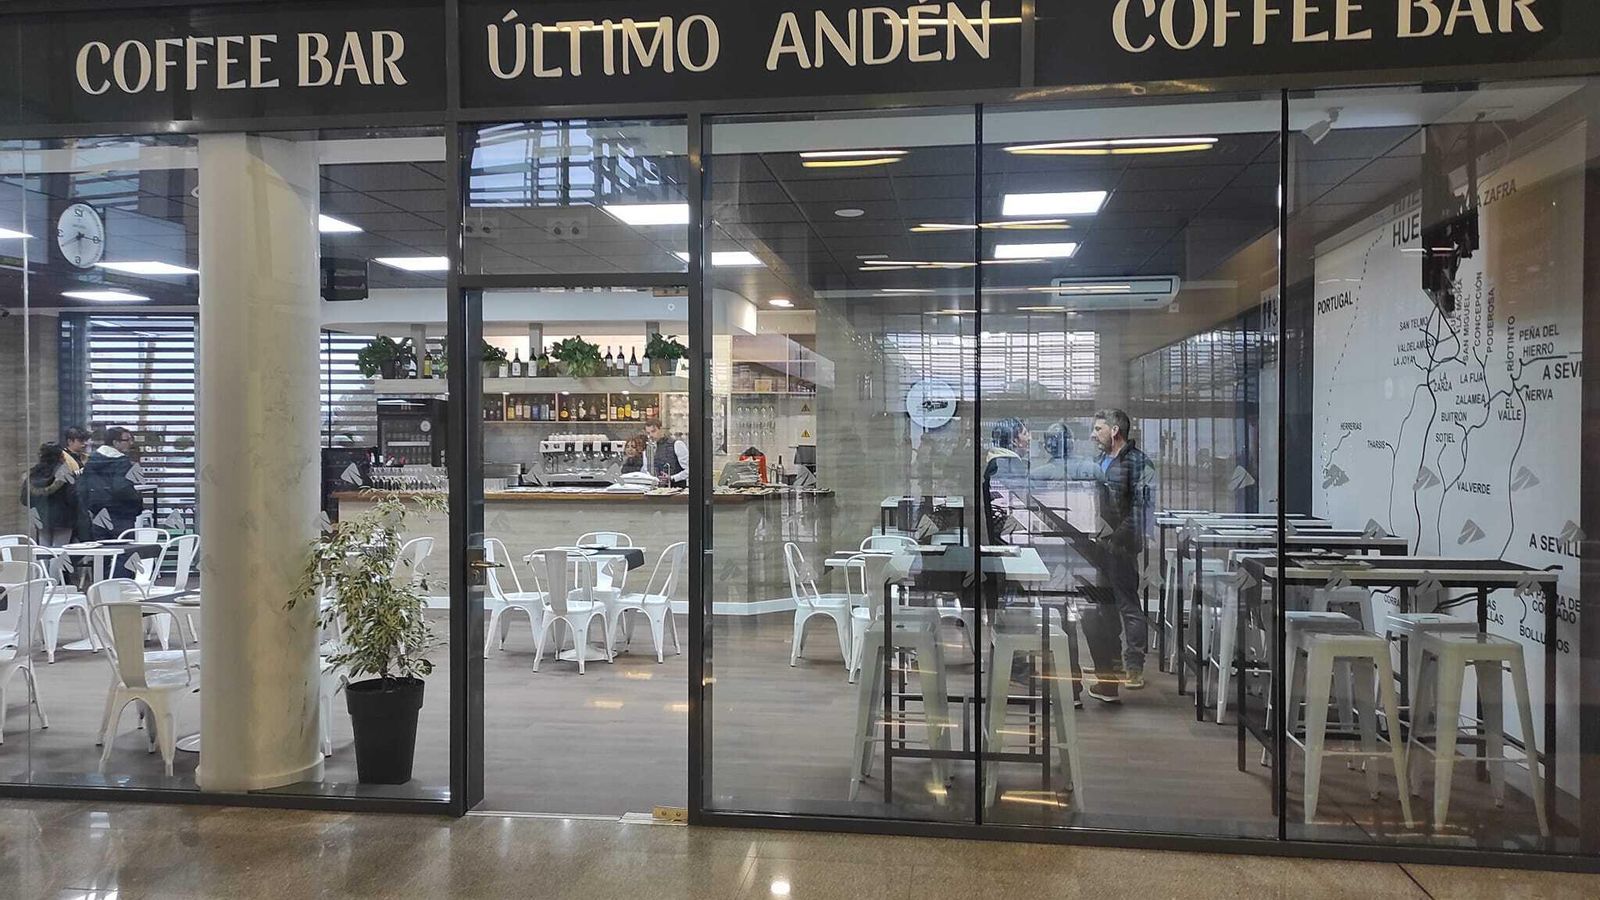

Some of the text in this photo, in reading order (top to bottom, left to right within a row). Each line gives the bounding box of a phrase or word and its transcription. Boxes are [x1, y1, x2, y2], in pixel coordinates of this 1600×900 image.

[1112, 0, 1544, 53] COFFEE BAR
[488, 0, 992, 80] ÚLTIMO ANDÉN
[76, 31, 408, 95] COFFEE BAR
[1483, 179, 1517, 206] ZAFRA
[1392, 213, 1420, 248] HUE
[1317, 290, 1353, 315] PORTUGAL
[1474, 271, 1482, 347] CONCEPCIÓN
[1399, 320, 1410, 331] SAN
[1463, 294, 1471, 336] MIGUEL
[1487, 287, 1495, 353] PODEROSA
[1519, 324, 1560, 341] PEÑA DEL
[1523, 342, 1554, 357] HIERRO
[1460, 373, 1468, 384] LA
[1542, 360, 1582, 381] A SEVI
[1455, 394, 1487, 405] ZALAMEA
[1505, 398, 1515, 410] EL
[1525, 388, 1554, 401] NERVA
[1497, 409, 1522, 421] VALLE
[1435, 432, 1456, 443] SOTIEL
[1456, 481, 1491, 495] VALVERDE
[1529, 533, 1580, 559] A SEVILL
[1532, 599, 1575, 624] COADO
[1567, 597, 1580, 613] DE
[1519, 625, 1569, 654] BOLLUOS
